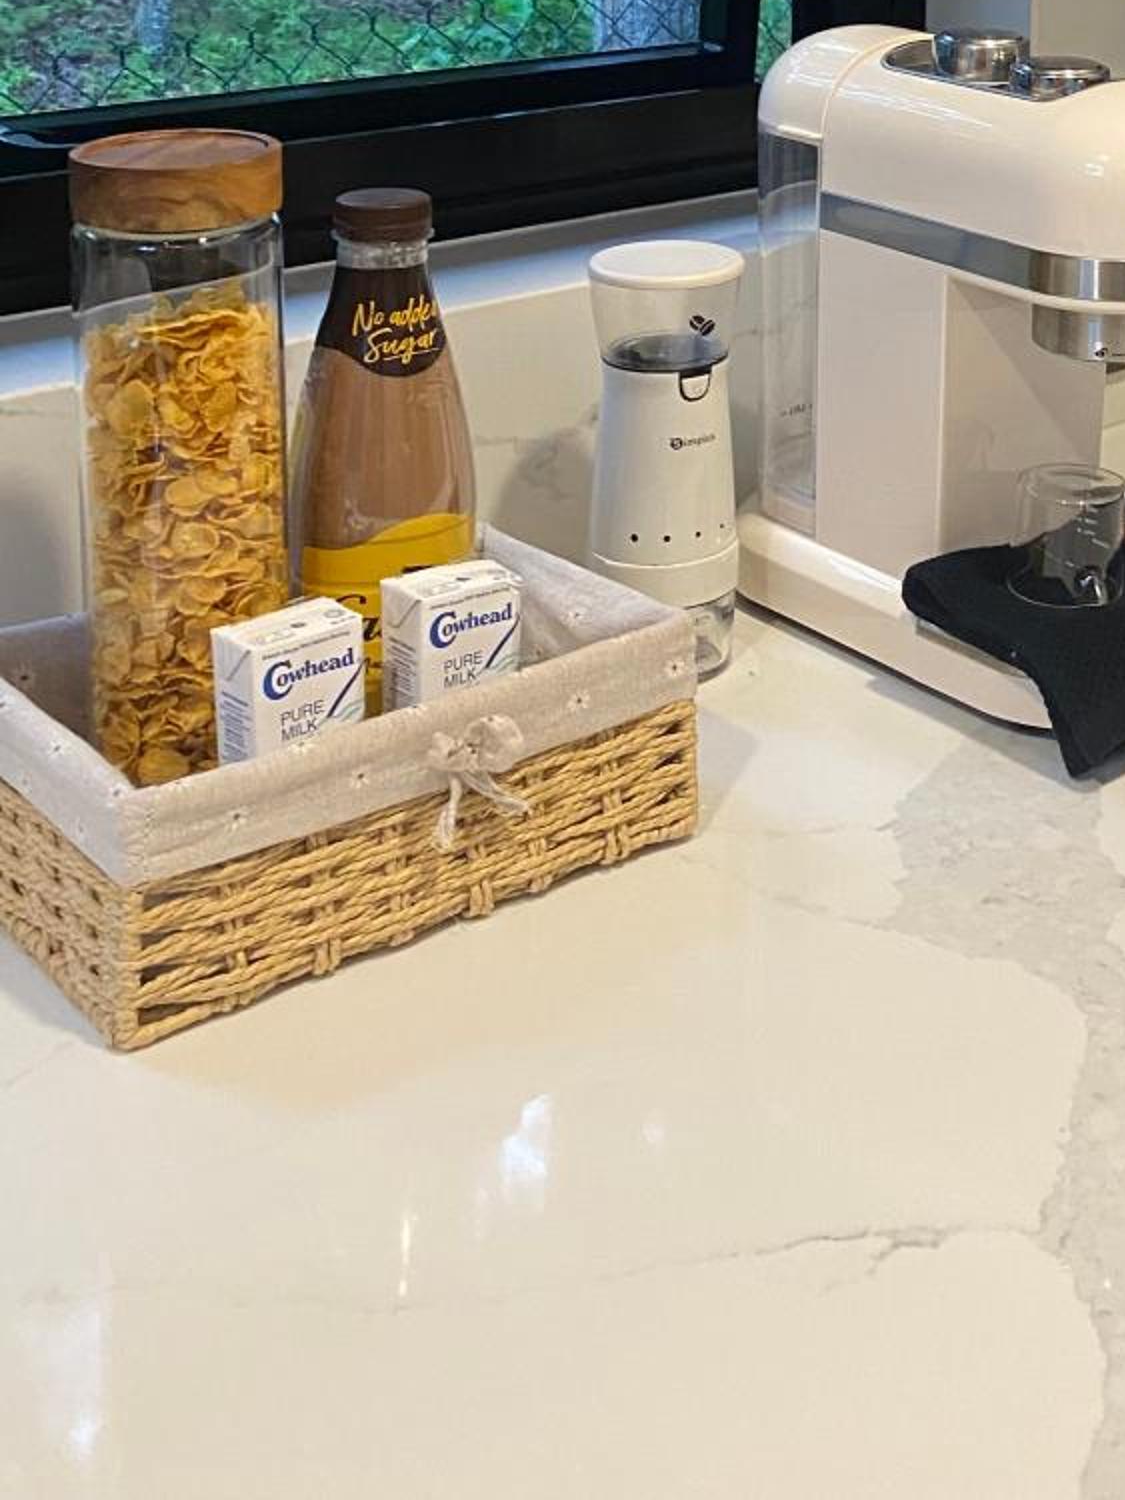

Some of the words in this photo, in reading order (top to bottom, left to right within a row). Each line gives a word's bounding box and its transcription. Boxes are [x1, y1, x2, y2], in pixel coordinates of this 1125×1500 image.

[351, 300, 385, 336] No
[363, 327, 439, 364] Sugar
[429, 602, 513, 649] Cowhead
[262, 647, 355, 701] Cowhead
[443, 650, 484, 674] PURE
[443, 668, 477, 689] MILK
[279, 699, 326, 727] PURE
[281, 719, 319, 742] MILK
